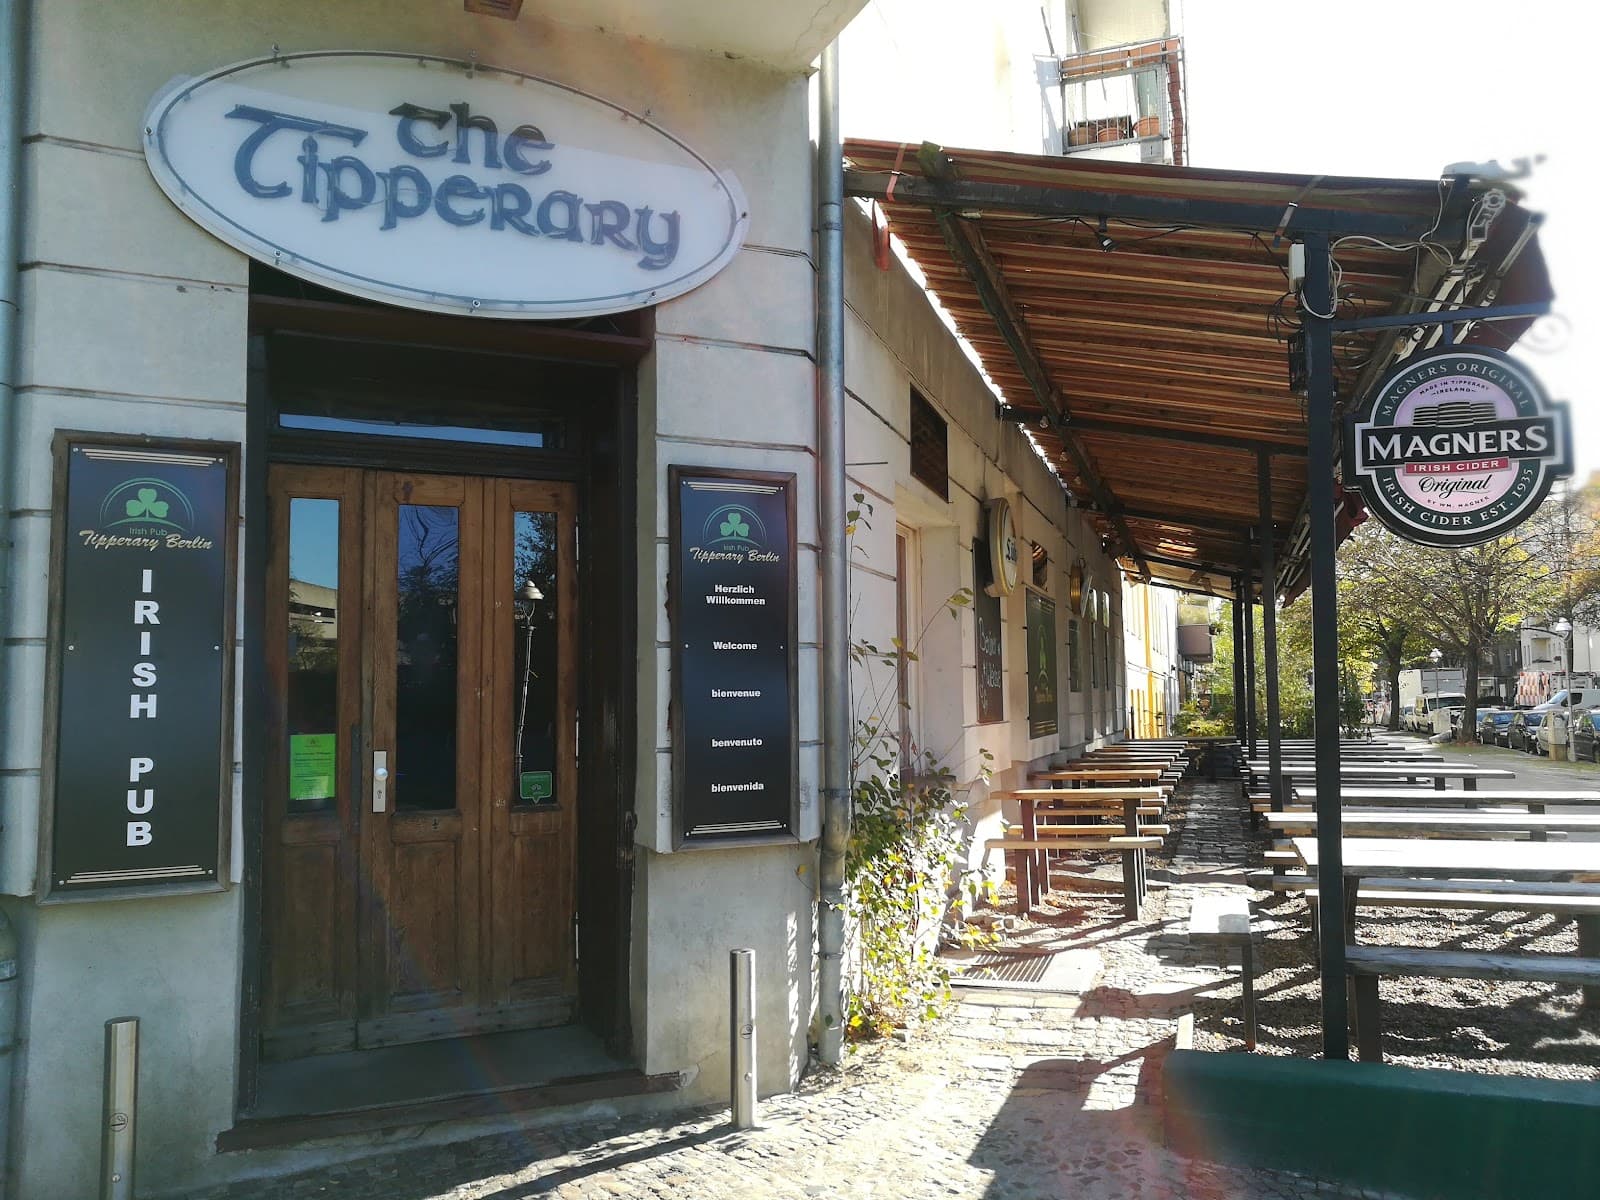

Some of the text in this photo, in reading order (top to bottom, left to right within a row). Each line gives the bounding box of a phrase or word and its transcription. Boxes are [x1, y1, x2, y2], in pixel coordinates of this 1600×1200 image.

[225, 104, 681, 270] Tipperary
[1382, 362, 1530, 416] MAGNERS ORIGINAL
[1419, 384, 1438, 396] MADE
[1367, 425, 1548, 461] MAGNERS
[1413, 460, 1500, 472] IRISH CIDER
[1418, 474, 1493, 499] Original
[1383, 468, 1534, 526] IRISH CIDER EST. 1935
[129, 527, 168, 536] Irish Pub
[79, 530, 213, 551] Tipperary Berlin
[689, 547, 780, 564] Tipperary Berlin
[714, 584, 755, 594] Herzlich
[705, 595, 766, 605] Willkommen
[713, 641, 758, 650] Welcome
[711, 689, 761, 698] bienvenue
[126, 569, 161, 847] IRISH PUB
[711, 738, 763, 748] benvenuto
[711, 782, 765, 793] bienvenida
